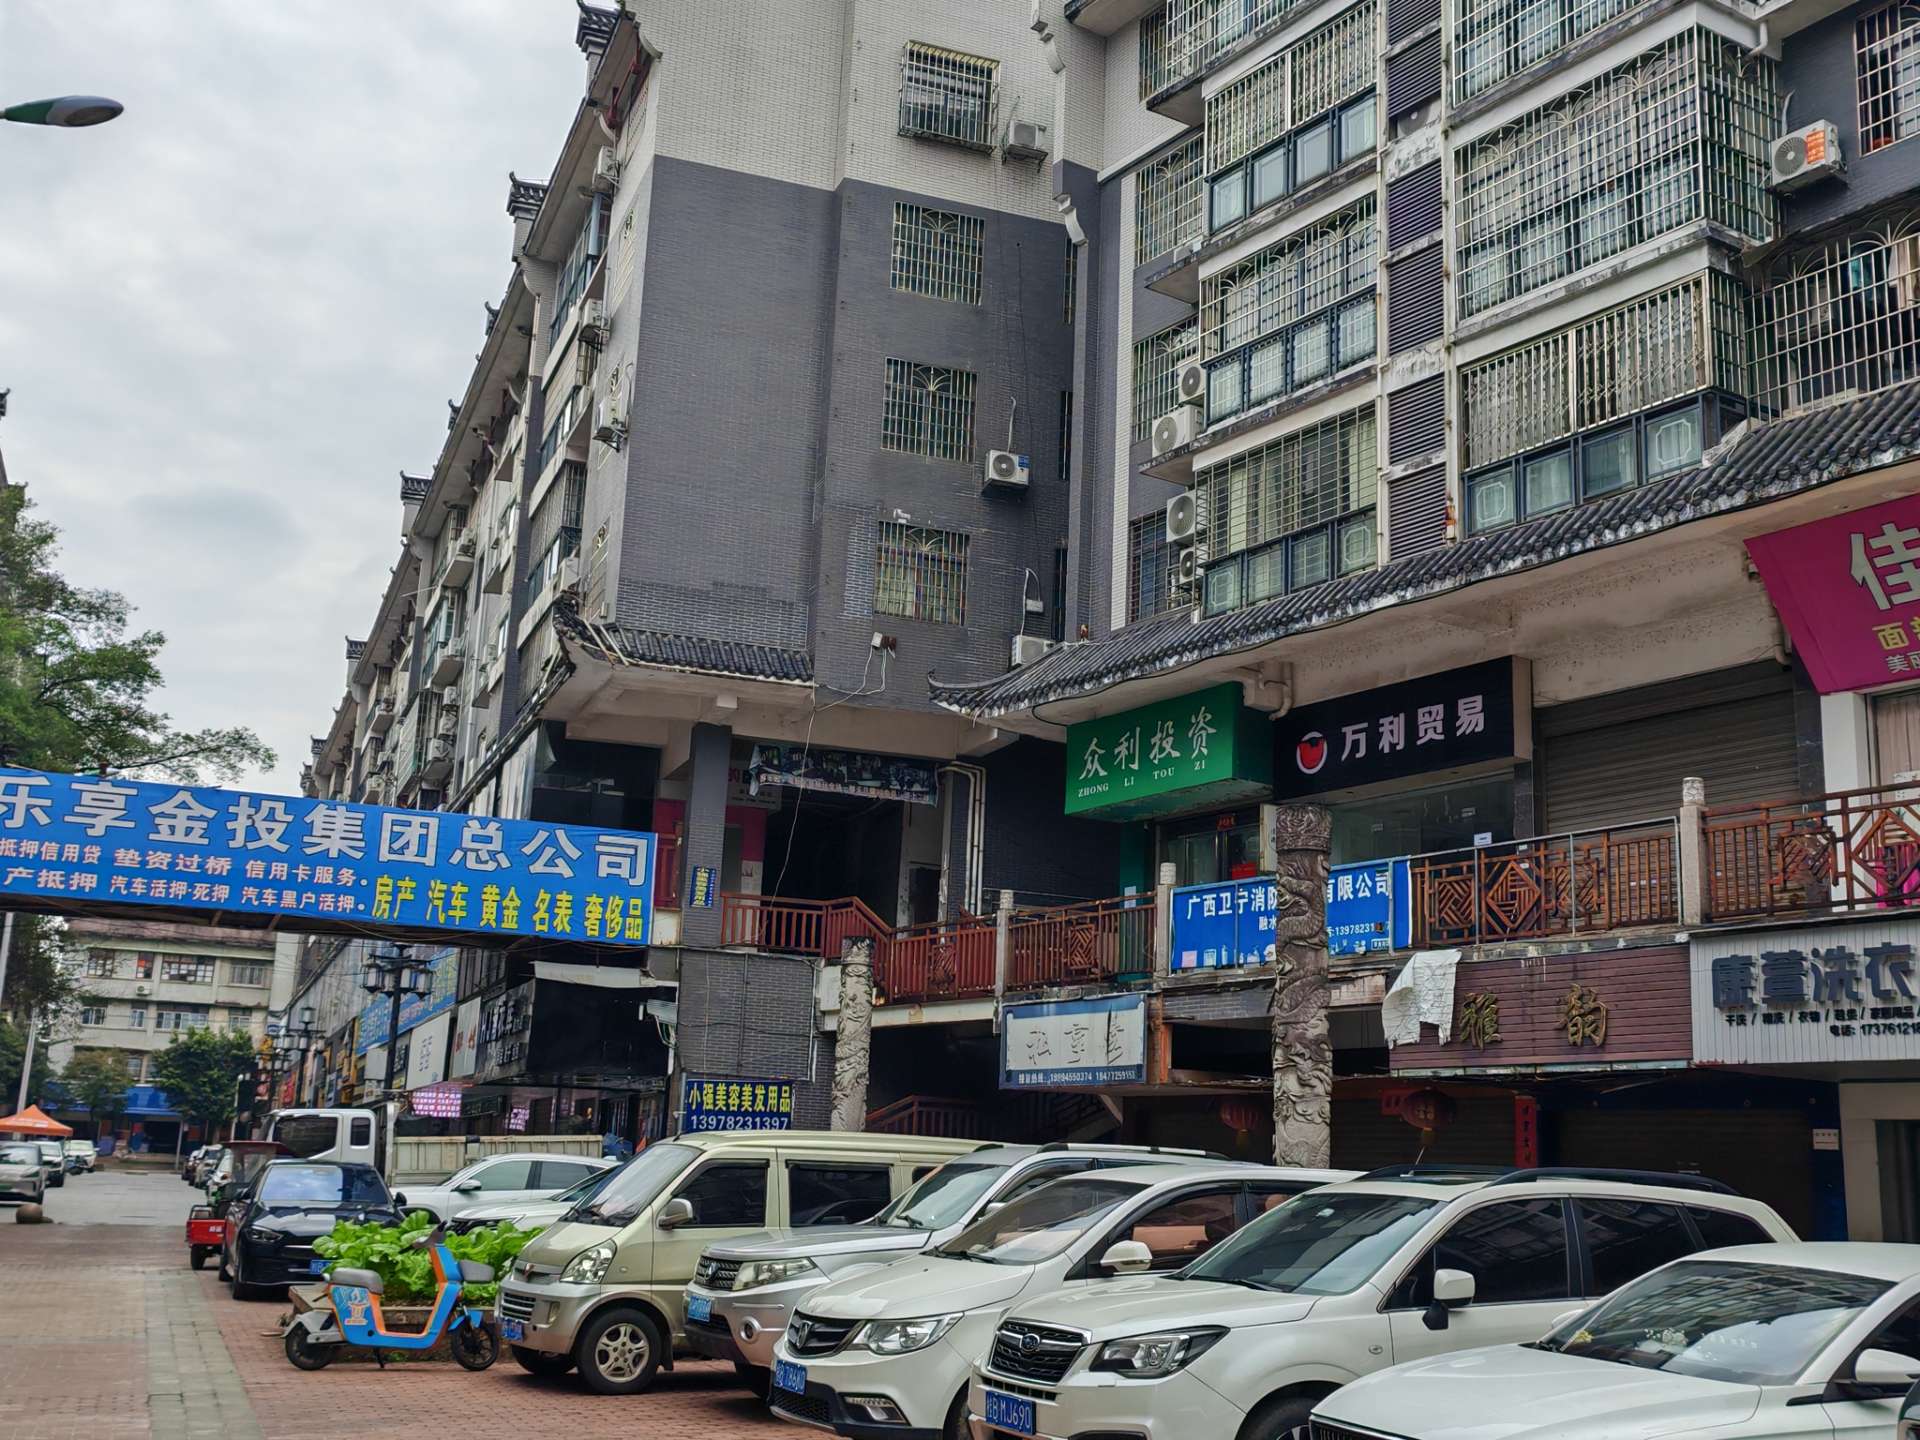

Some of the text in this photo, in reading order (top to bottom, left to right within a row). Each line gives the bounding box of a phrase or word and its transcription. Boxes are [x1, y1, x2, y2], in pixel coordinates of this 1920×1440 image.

[1079, 706, 1217, 780] 众利投资
[1341, 694, 1485, 761] 万利贸易
[1078, 759, 1205, 798] ZHONG LI TOU ZI
[0, 776, 647, 886] 乐享金投集团总公司
[0, 838, 356, 886] 抵押信用贷 垫资过桥 信用卡服务
[4, 867, 98, 893] 产抵押
[241, 886, 355, 913] 汽车黑户活押
[372, 874, 642, 940] 房产 汽车 黄金 名表 奢侈品
[689, 1082, 791, 1112] 小强美容美发用品
[691, 1115, 788, 1130] 13978231397
